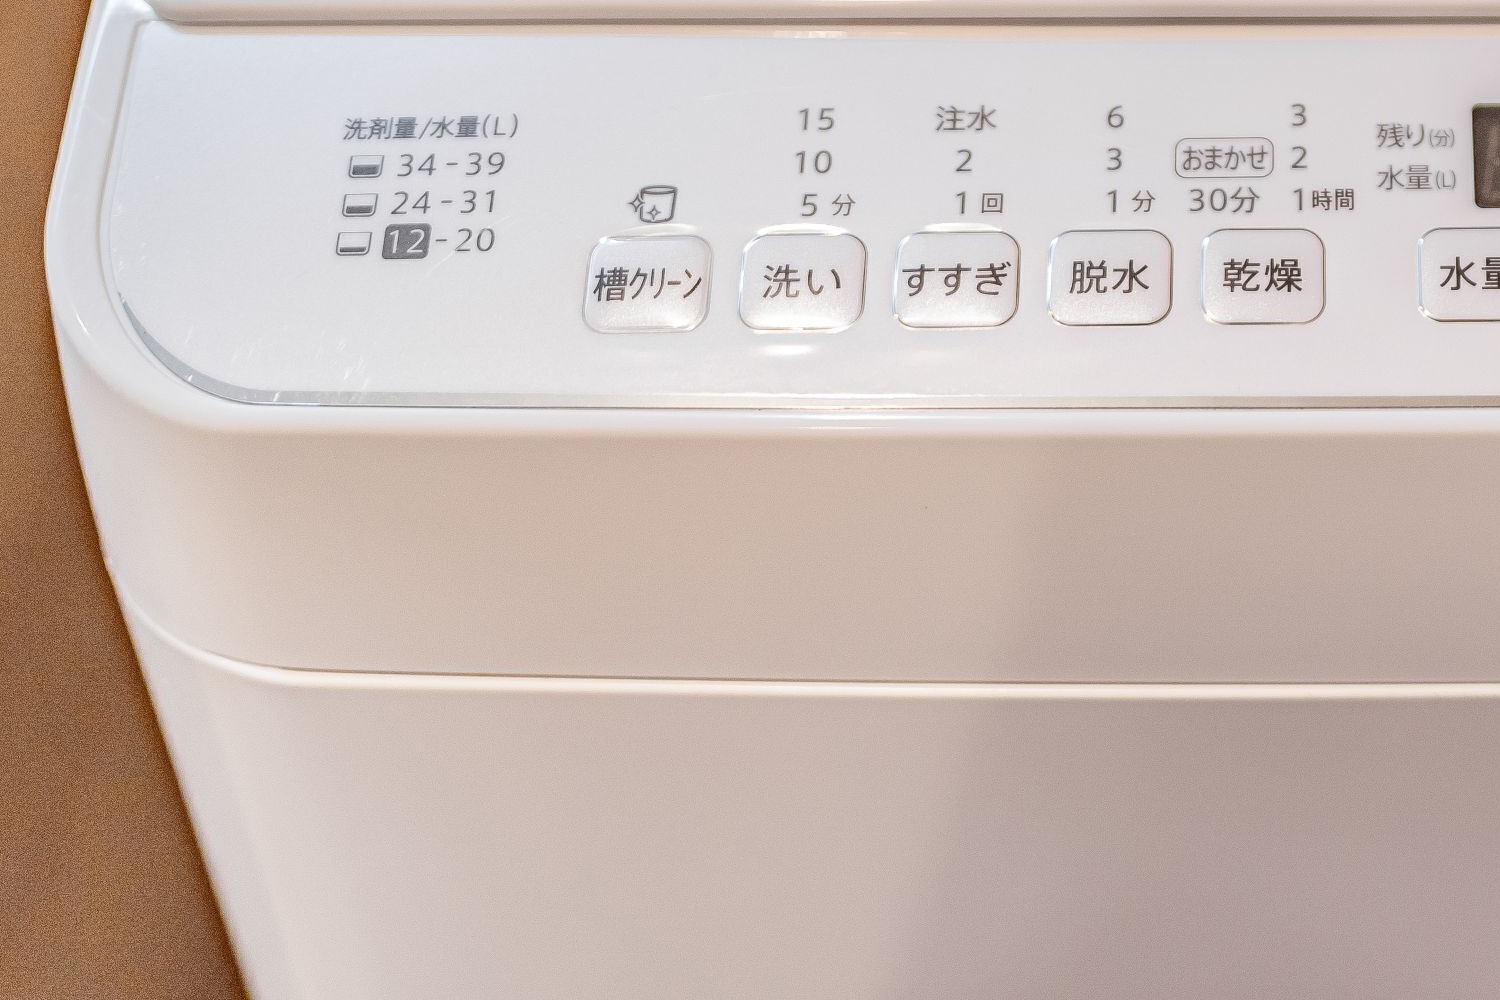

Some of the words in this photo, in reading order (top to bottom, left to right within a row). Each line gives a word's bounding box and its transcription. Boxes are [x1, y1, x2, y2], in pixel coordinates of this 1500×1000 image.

[342, 113, 519, 141] 洗剤量/水量(L)
[799, 107, 835, 132] 15
[935, 104, 997, 132] 注水
[1105, 104, 1125, 129] 6
[1291, 103, 1308, 128] 3
[396, 151, 506, 178] 34-39
[795, 150, 833, 175] 10
[954, 148, 973, 173] 2
[1106, 147, 1123, 171] 3
[1181, 144, 1269, 171] おまかせ
[1291, 145, 1308, 169] 2
[390, 189, 496, 215] 24-31
[1189, 186, 1261, 214] 30分
[592, 266, 703, 303] 槽クリーン
[762, 263, 842, 299] 洗い
[901, 260, 1012, 297] すすぎ
[1069, 258, 1150, 295] 脱水
[1222, 257, 1303, 293] 乾燥
